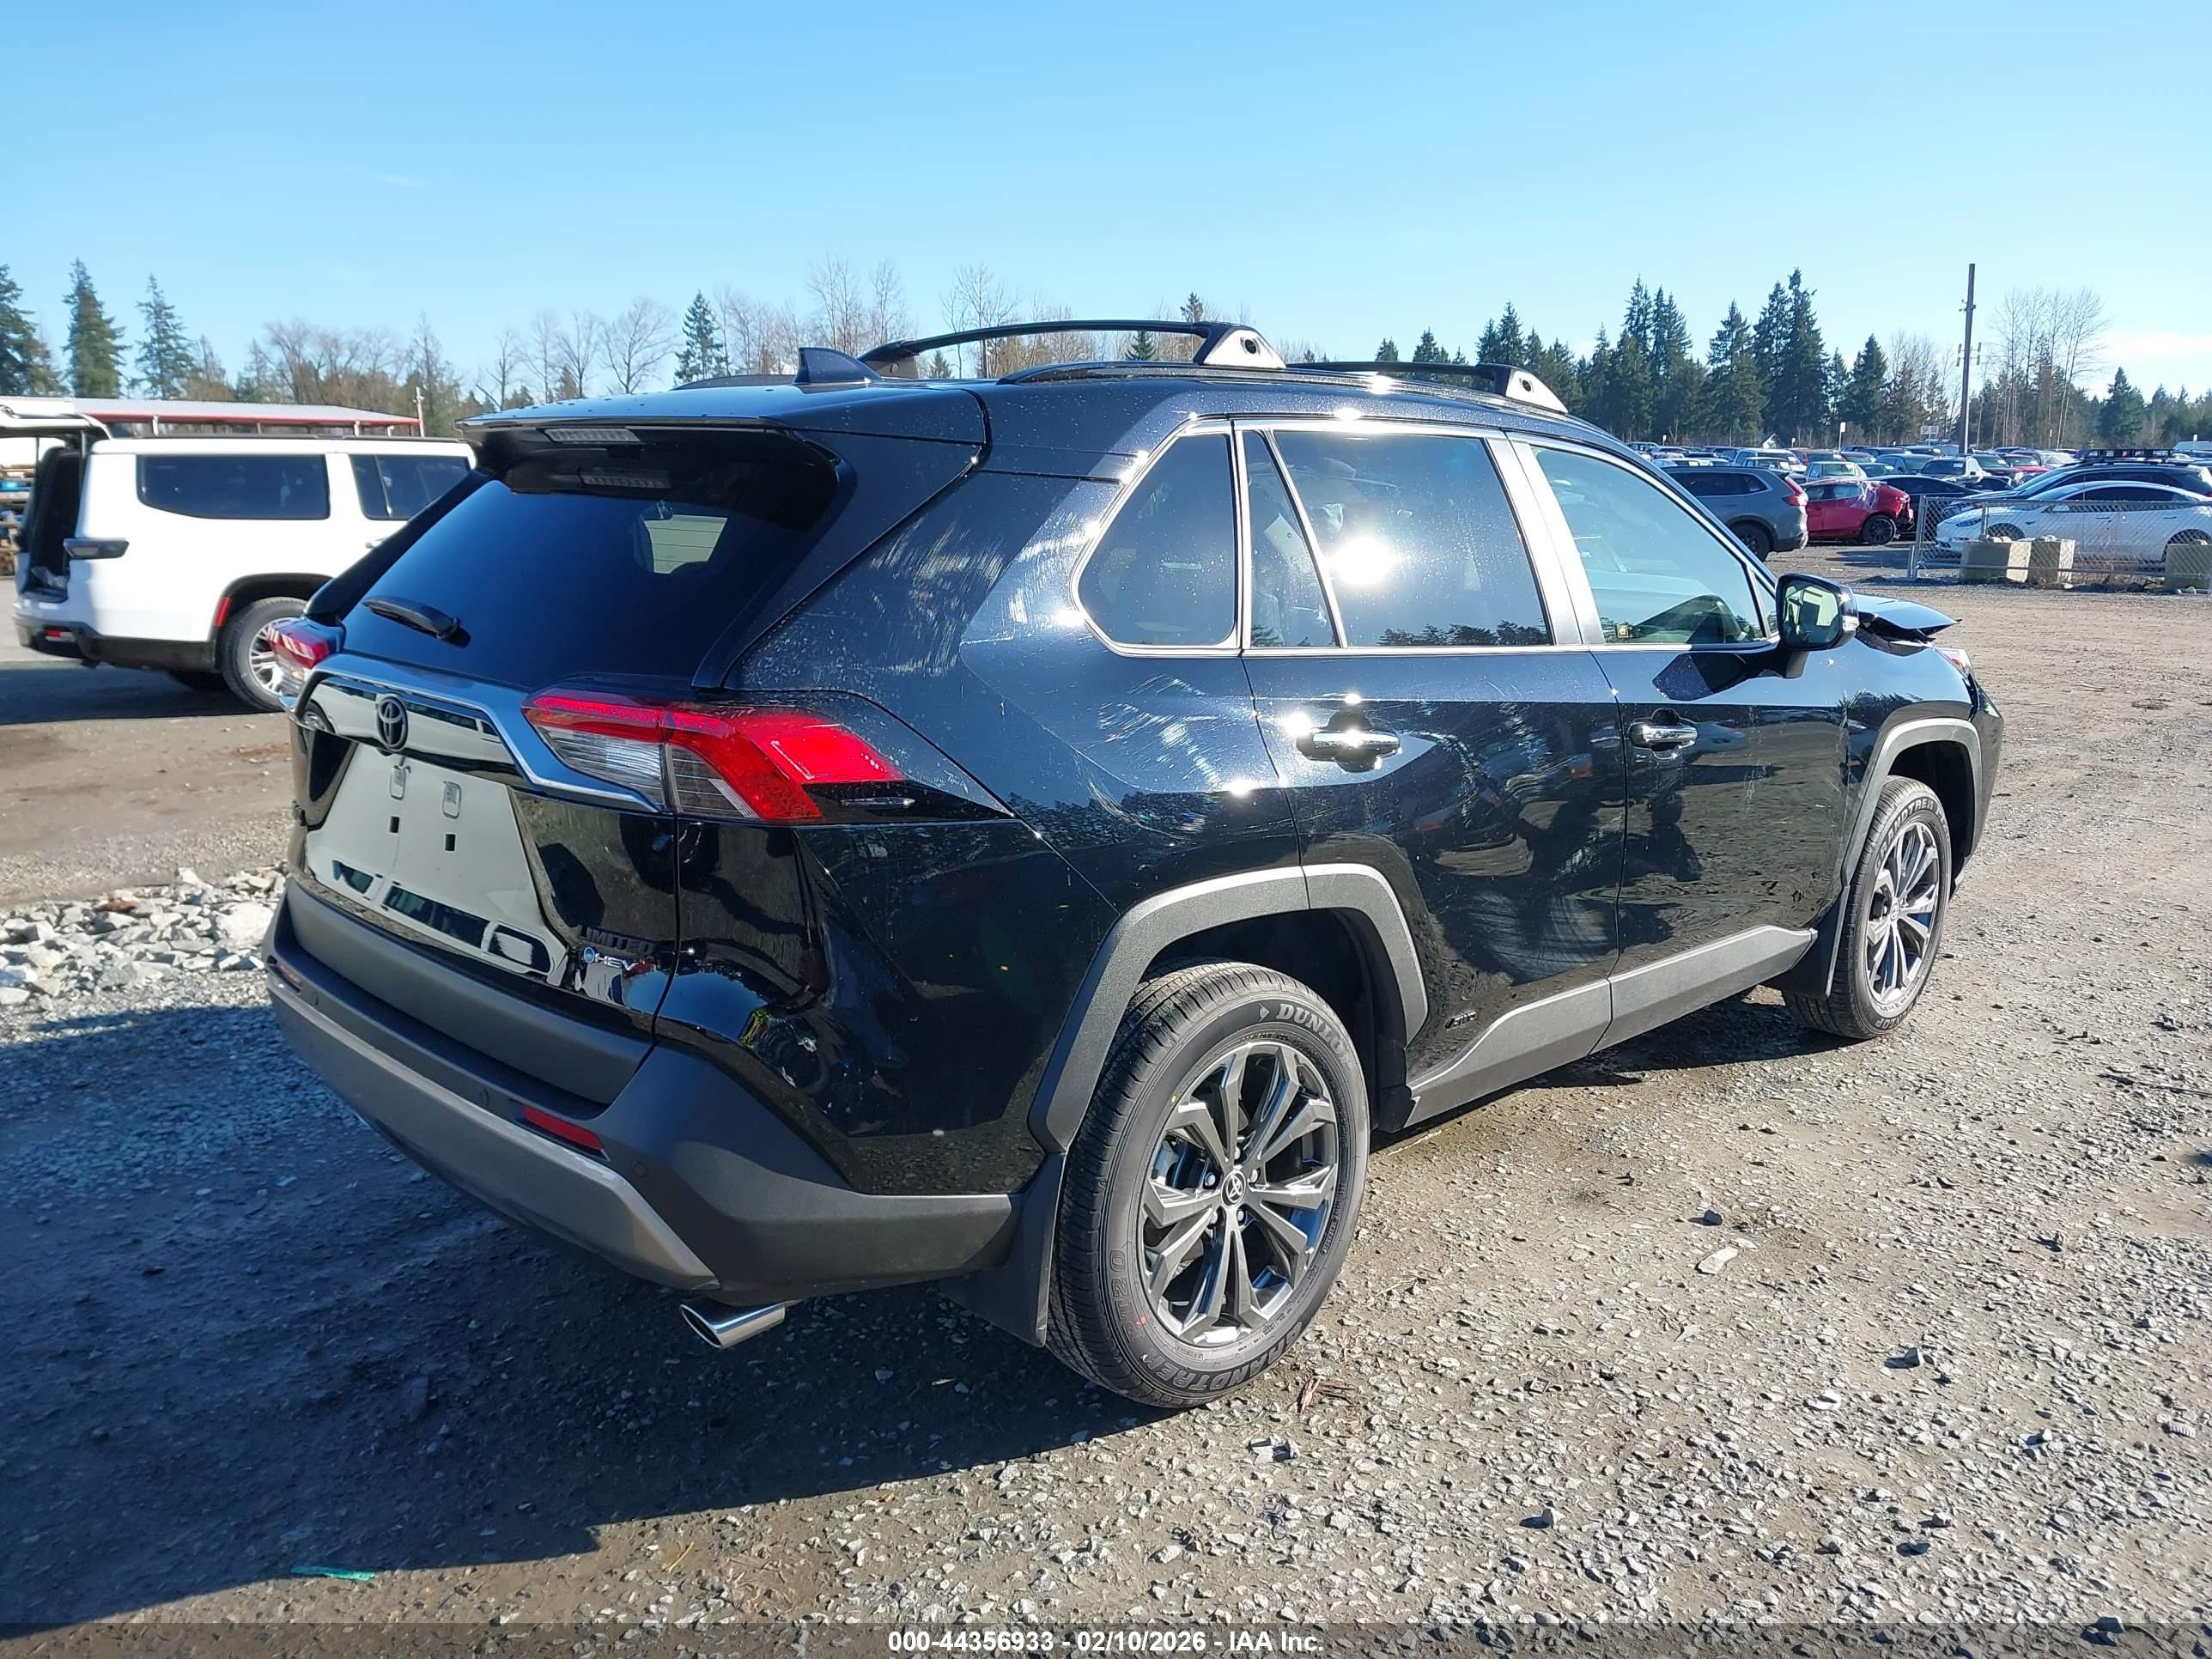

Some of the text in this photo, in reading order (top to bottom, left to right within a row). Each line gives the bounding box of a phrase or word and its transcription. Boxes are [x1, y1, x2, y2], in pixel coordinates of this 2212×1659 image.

[576, 923, 655, 956] LIMITED
[1275, 1002, 1353, 1071] DUNLOP
[1139, 1321, 1304, 1391] GRANDTREK
